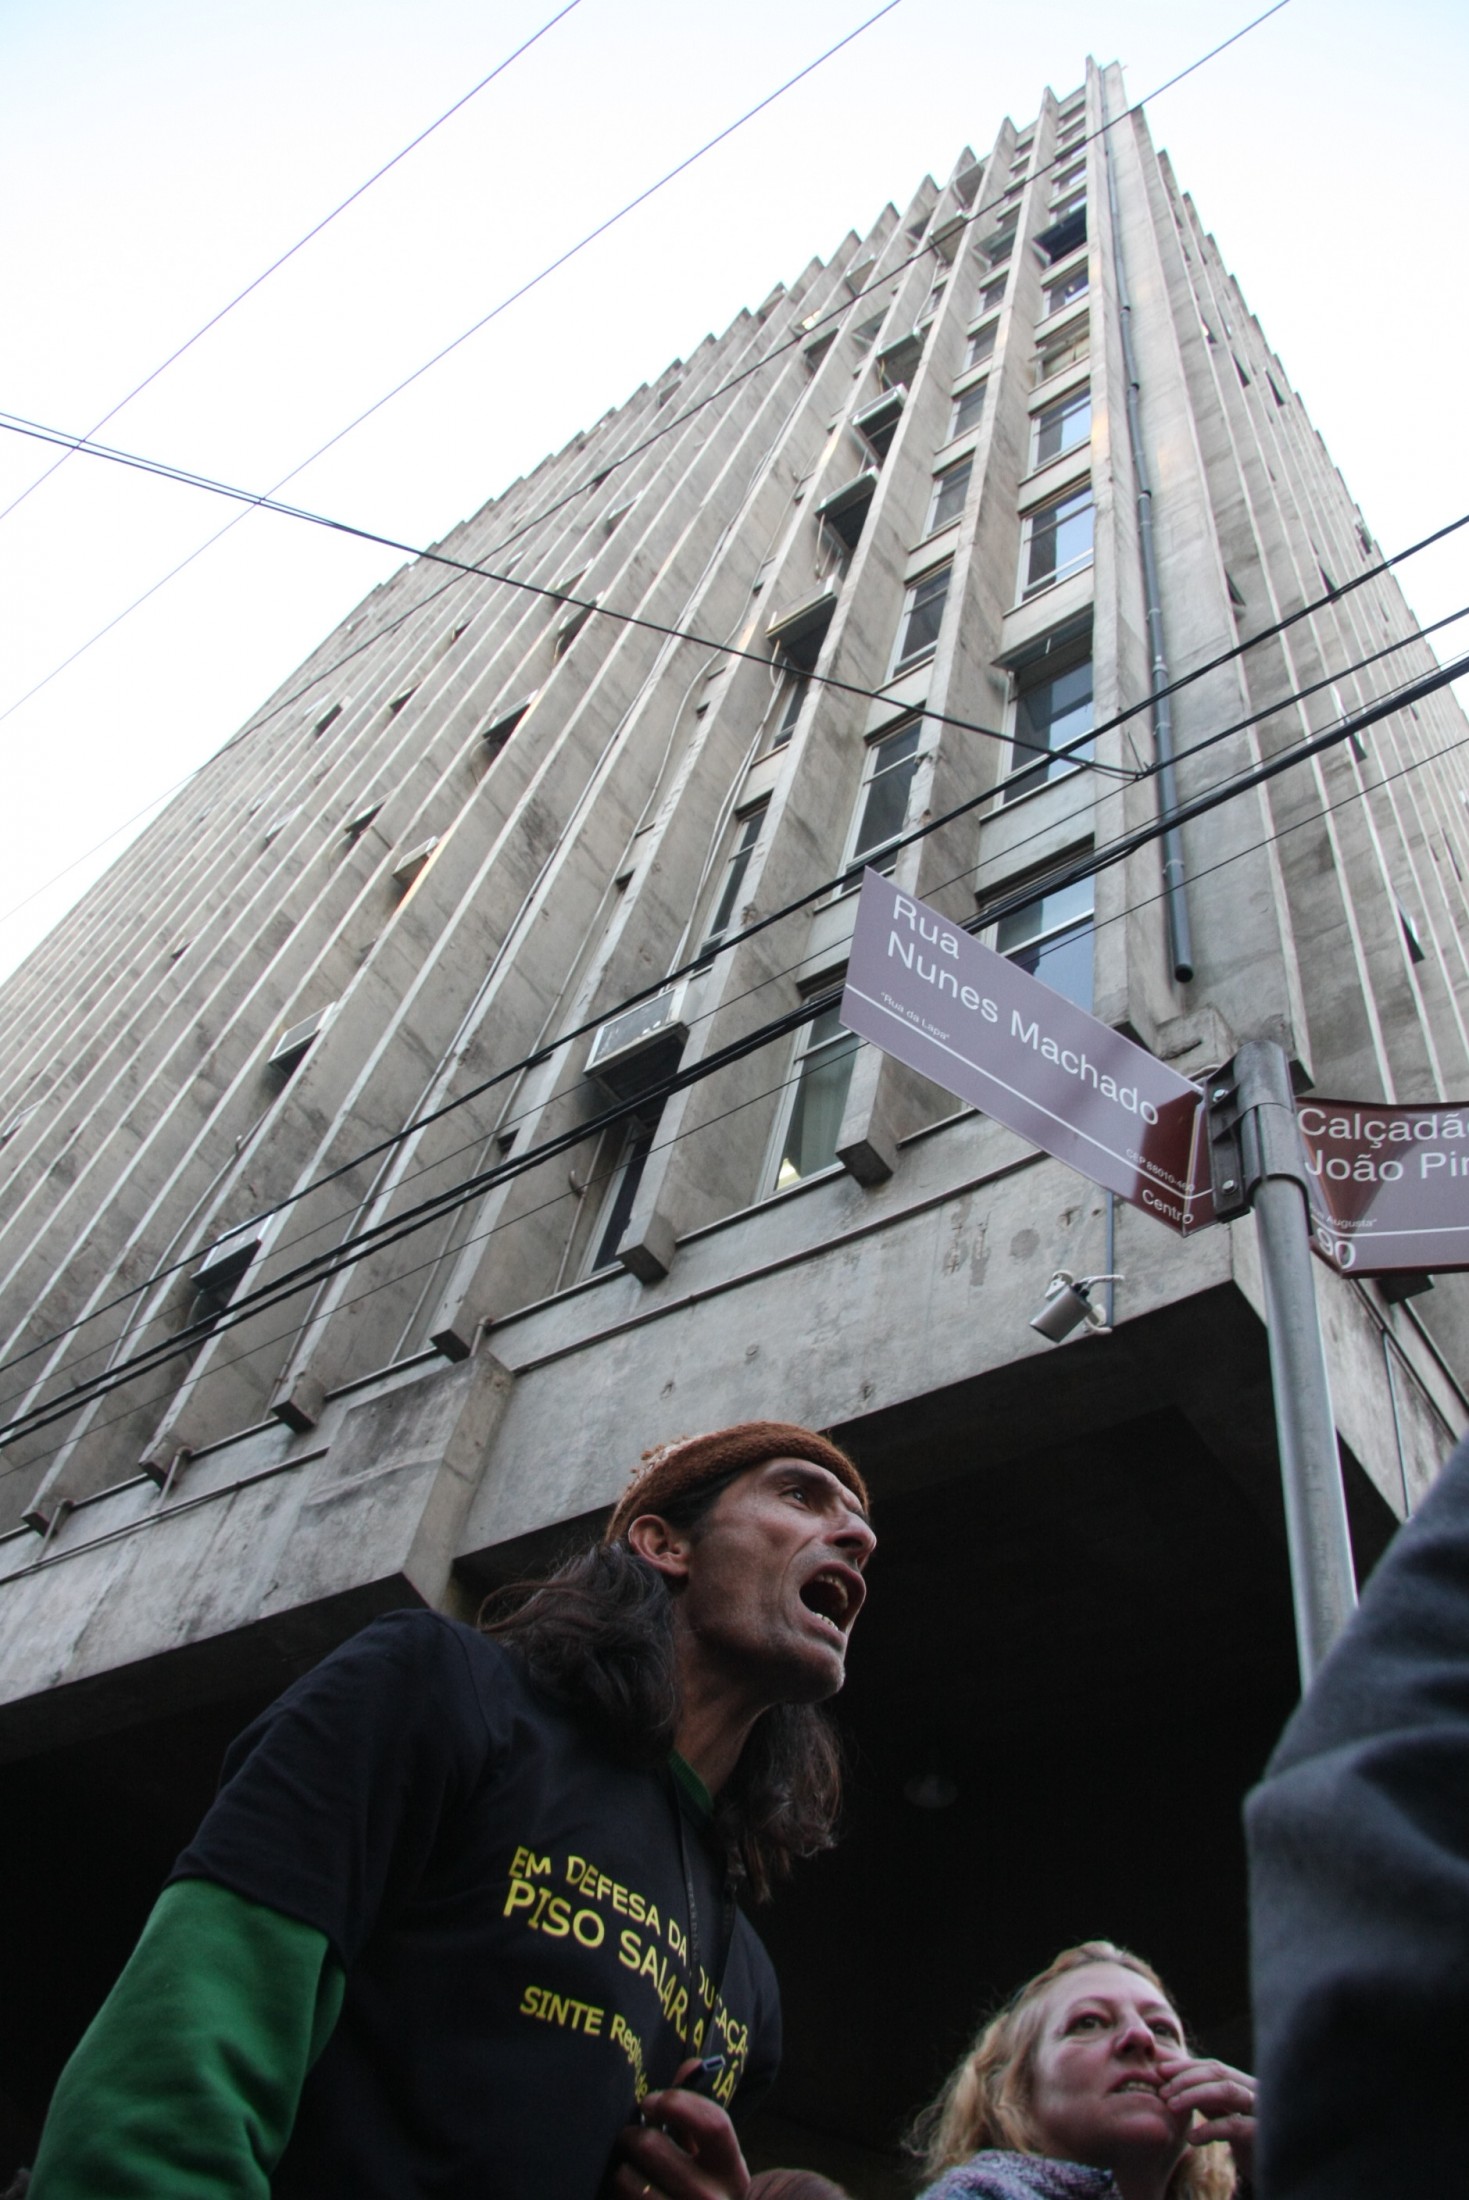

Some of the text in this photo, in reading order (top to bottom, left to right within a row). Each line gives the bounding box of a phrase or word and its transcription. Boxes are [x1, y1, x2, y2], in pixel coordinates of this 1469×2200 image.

[893, 894, 959, 960] Rua
[887, 930, 1159, 1126] Nunes Machado
[906, 1010, 920, 1023] da
[1298, 1108, 1469, 1148] Calçadã
[1126, 1148, 1146, 1165] CEP
[1304, 1149, 1404, 1182] João
[1142, 1189, 1195, 1225] Centro
[1317, 1227, 1356, 1270] 90
[503, 1879, 605, 1949] PISO
[509, 1846, 551, 1880] EM
[565, 1855, 661, 1937] DEFESA
[668, 1918, 687, 1967] DA
[520, 1985, 604, 2036] SINTE
